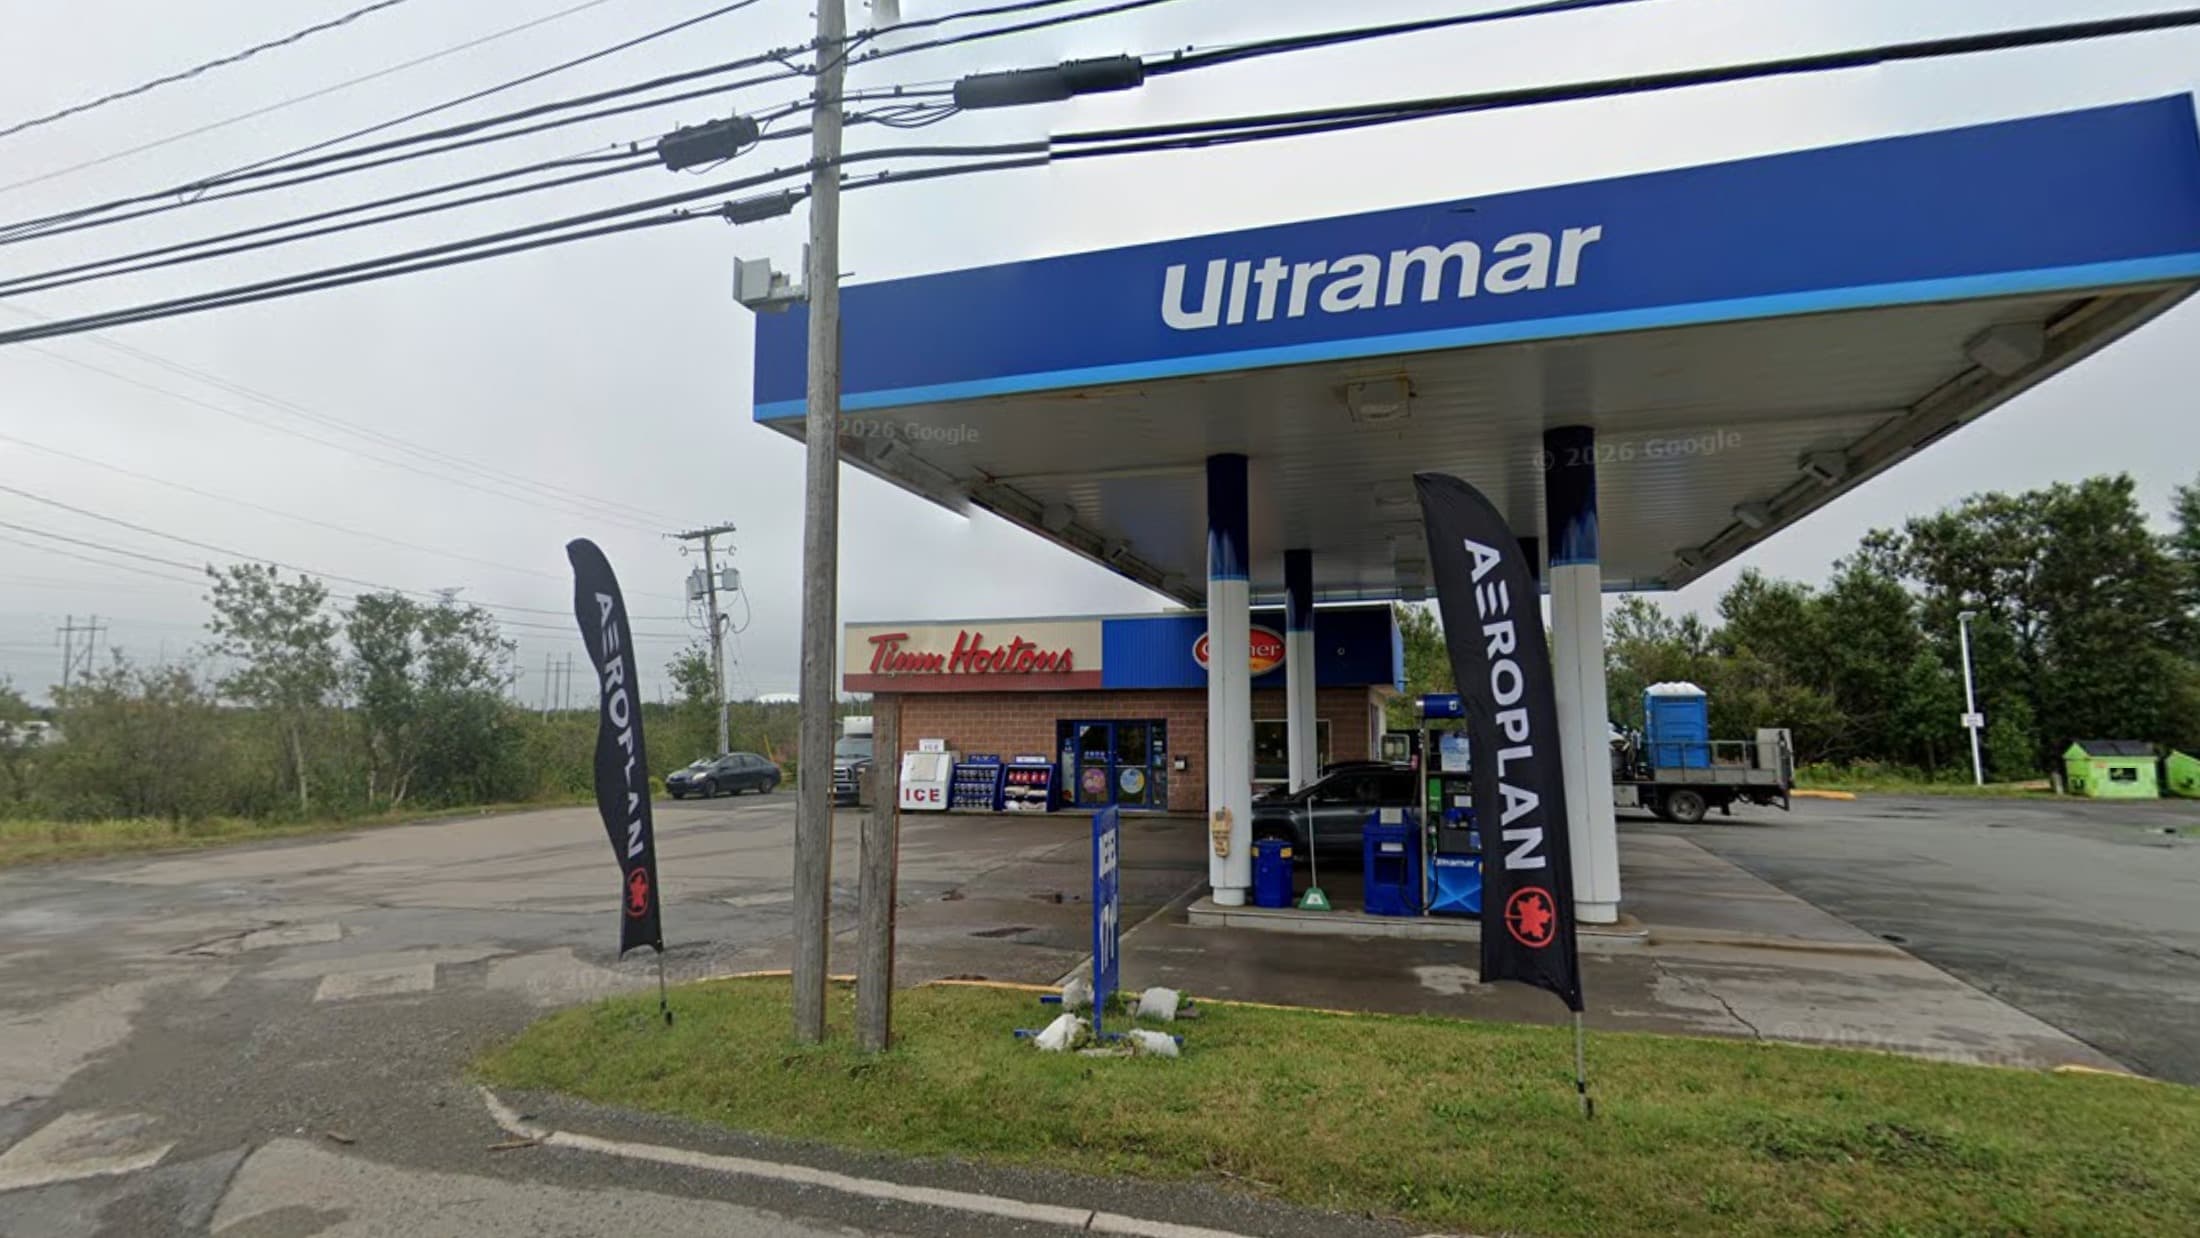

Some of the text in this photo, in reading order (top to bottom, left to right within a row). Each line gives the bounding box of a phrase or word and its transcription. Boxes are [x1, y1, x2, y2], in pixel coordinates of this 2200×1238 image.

[1161, 224, 1602, 330] Ultramar
[948, 630, 1073, 673] Hortons
[1463, 538, 1547, 870] AEROPLAN
[595, 591, 643, 860] AEROPLAN
[905, 788, 941, 802] ICE
